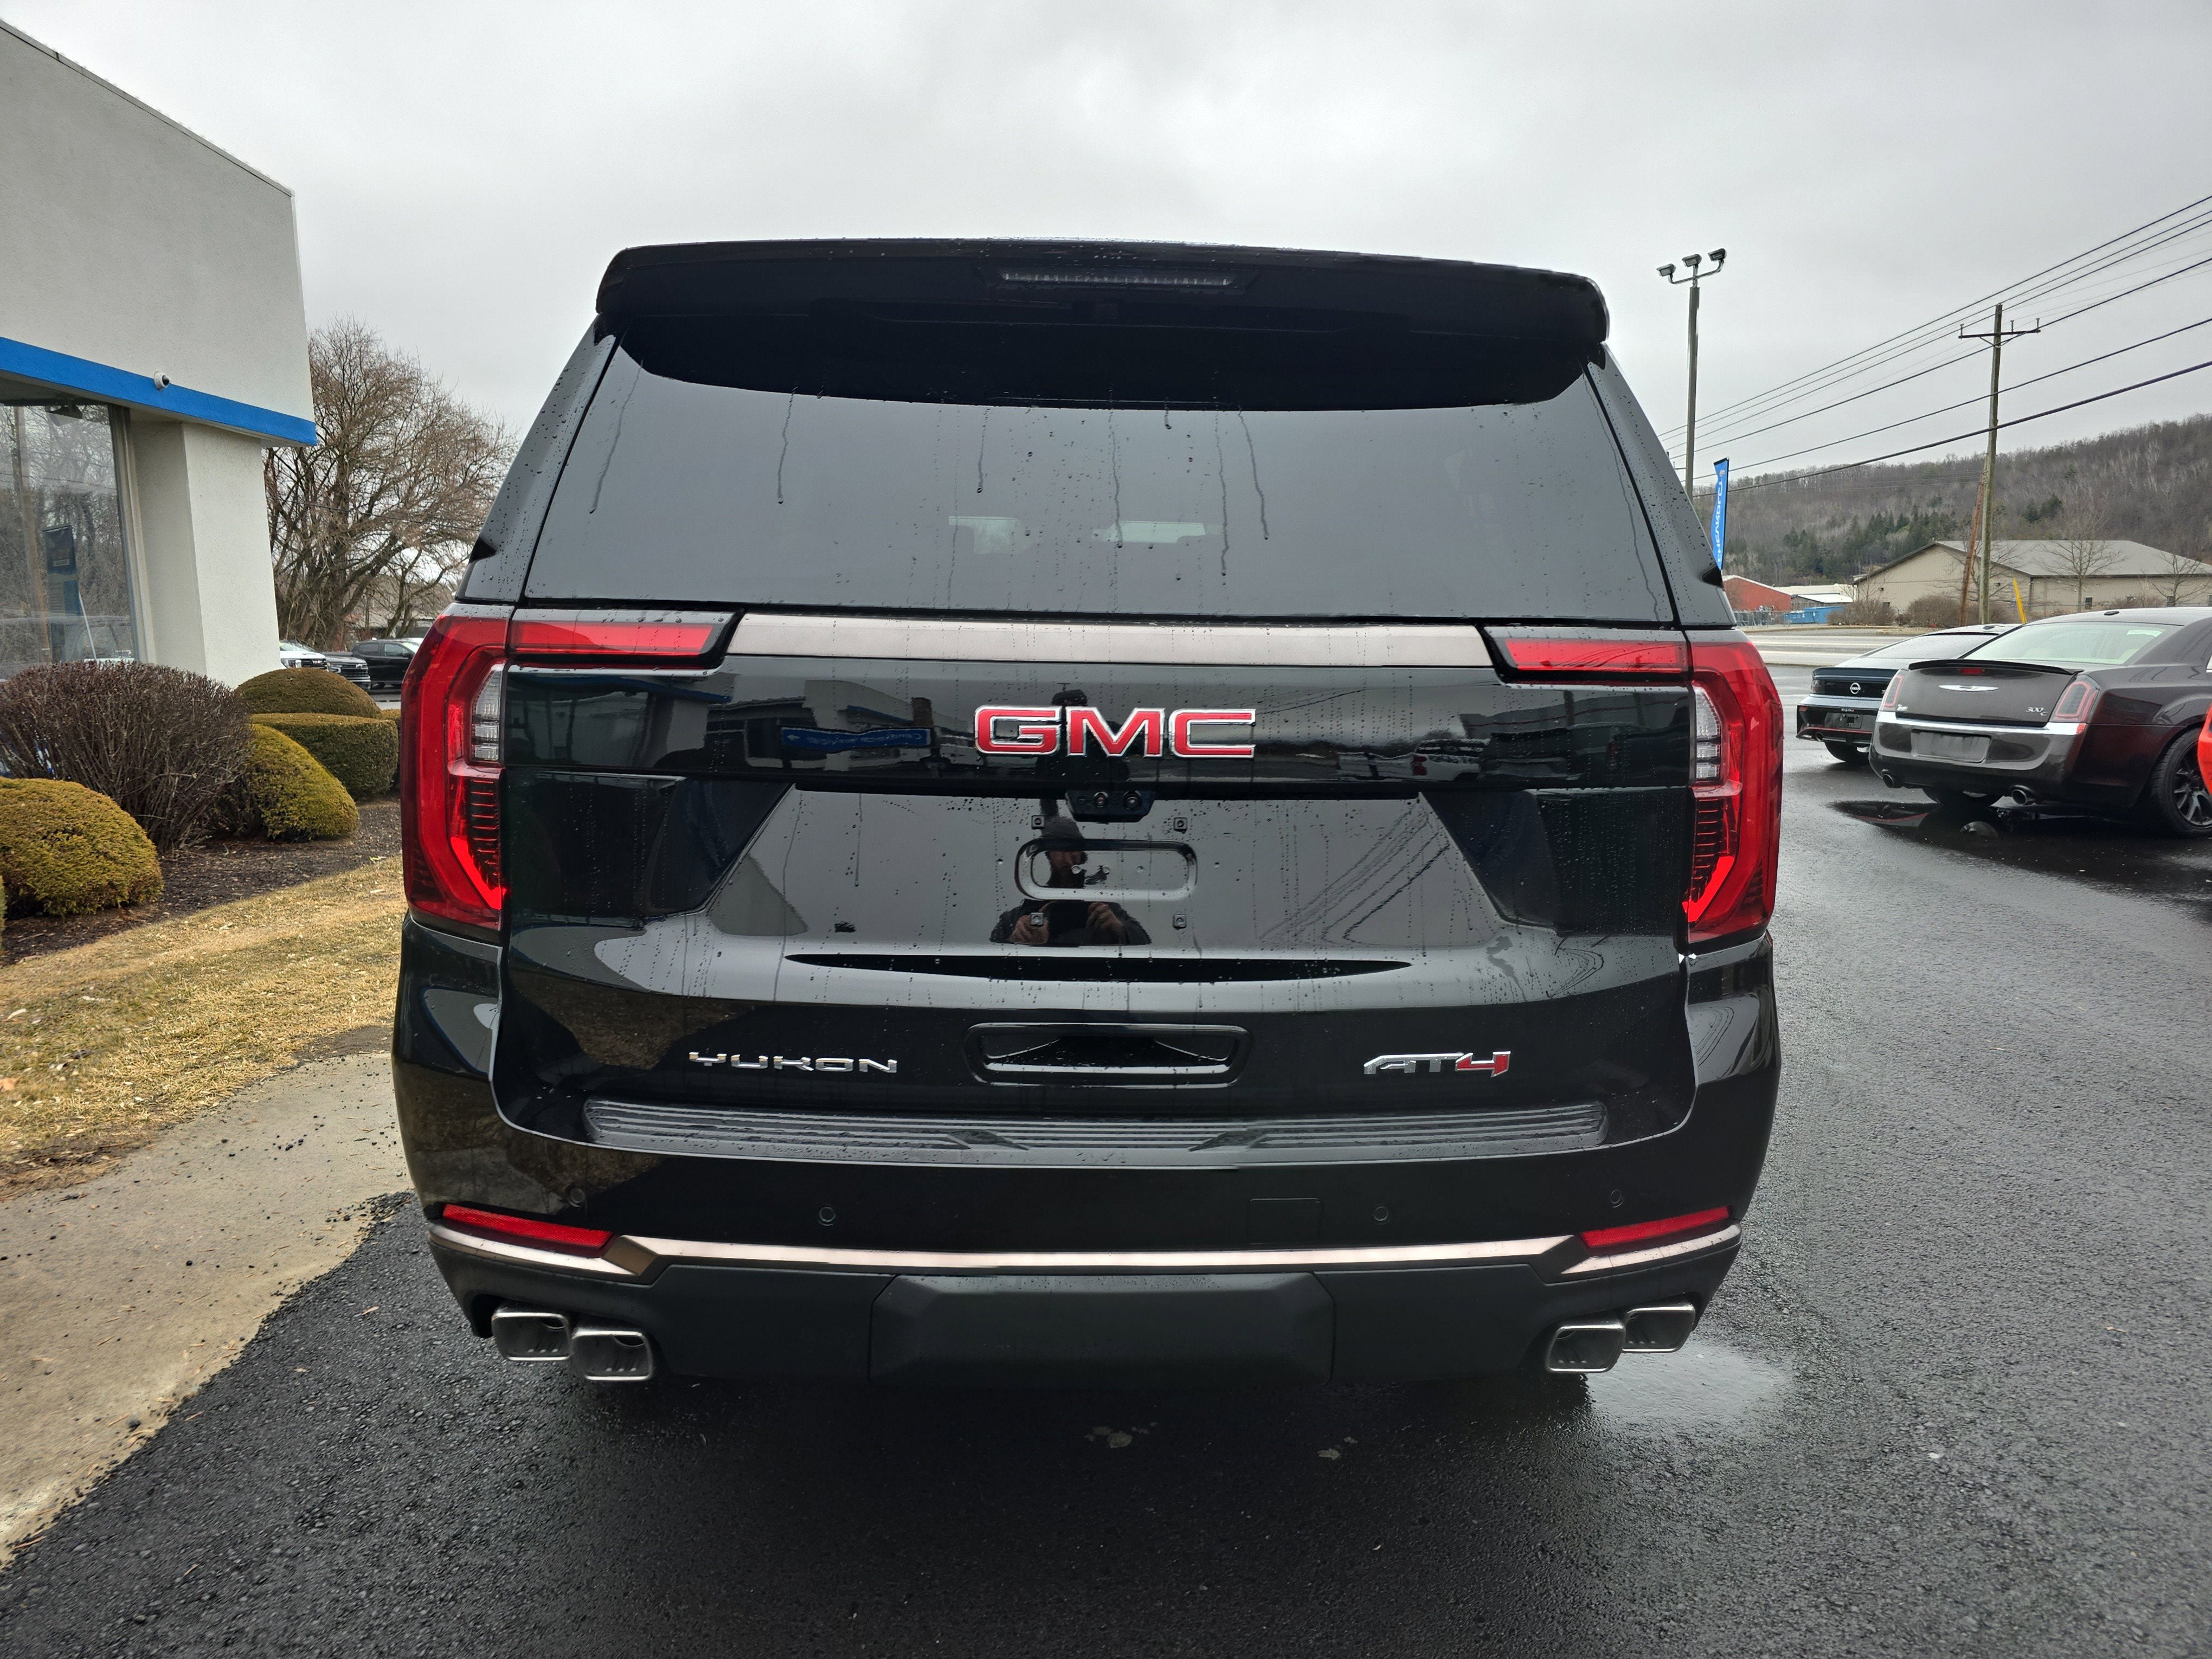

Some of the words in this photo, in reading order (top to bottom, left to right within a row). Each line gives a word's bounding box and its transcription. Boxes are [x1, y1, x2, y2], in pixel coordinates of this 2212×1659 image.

[974, 705, 1257, 758] GMC
[689, 1051, 898, 1073] YUKON
[1364, 1051, 1511, 1078] AT4
